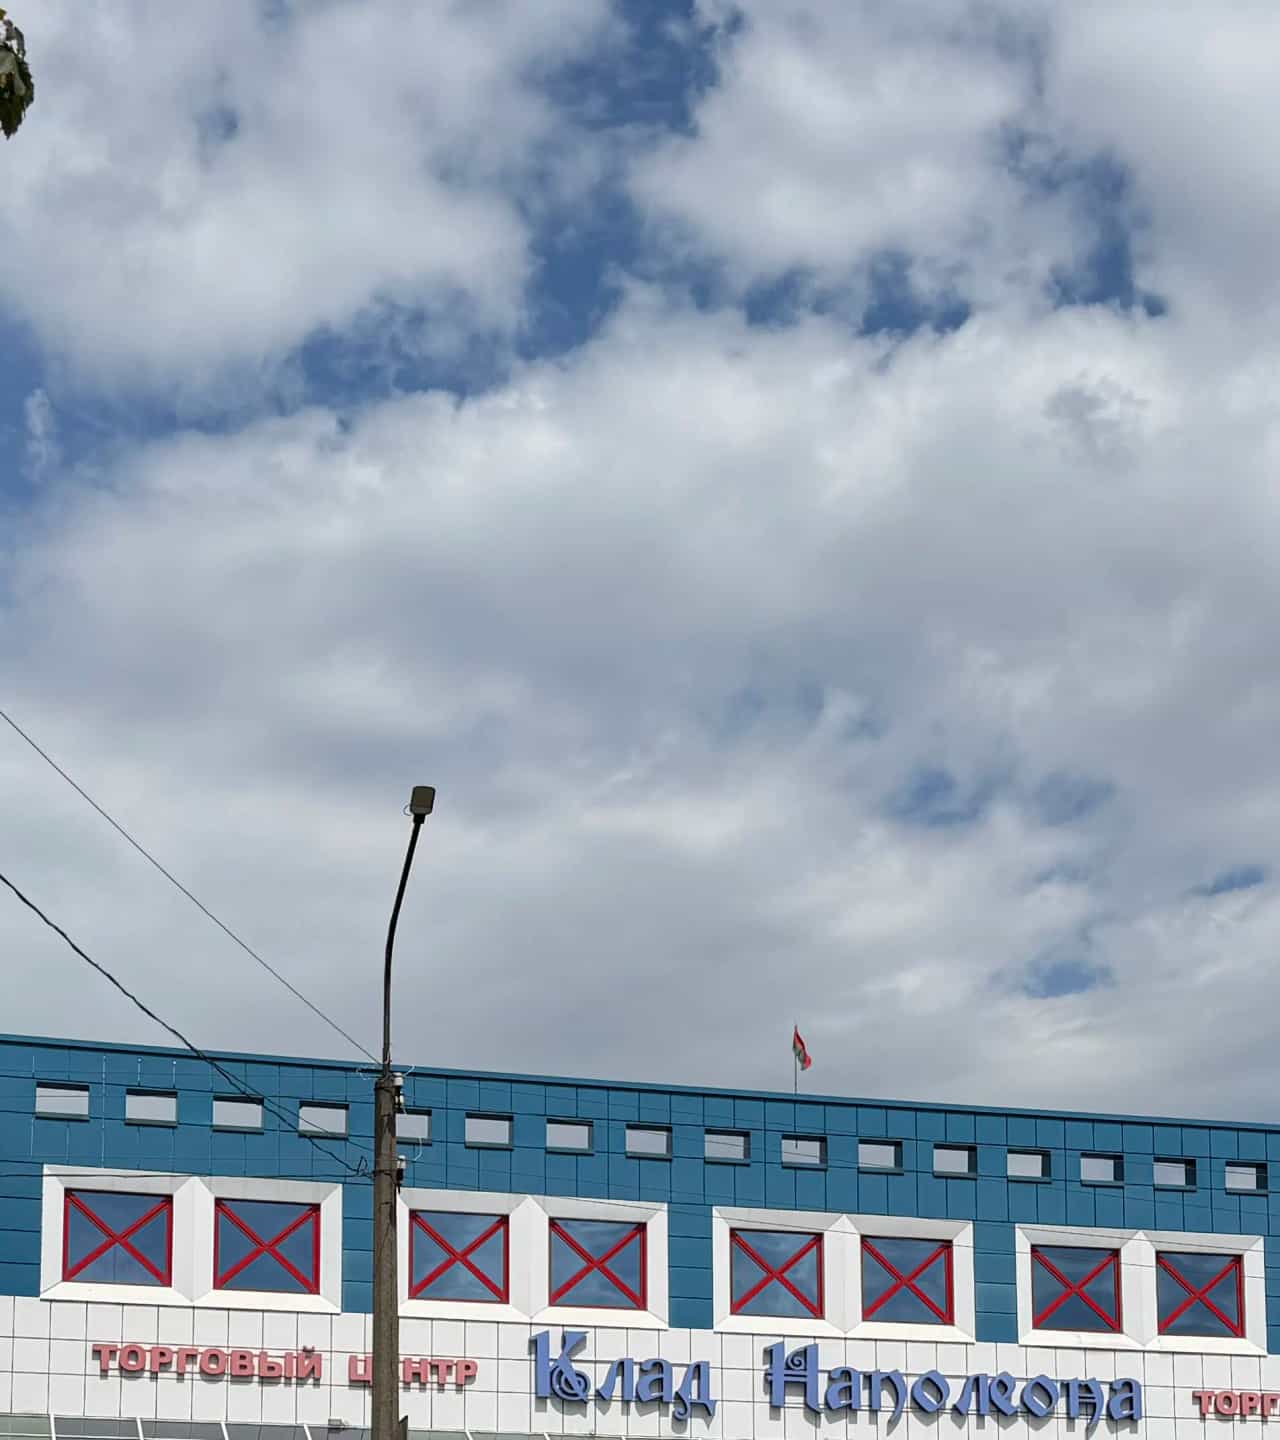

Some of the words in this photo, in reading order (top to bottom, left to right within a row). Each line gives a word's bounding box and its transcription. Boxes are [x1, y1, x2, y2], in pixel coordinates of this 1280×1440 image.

[92, 1344, 323, 1379] ТОРГОВЫЙ
[348, 1354, 479, 1386] ЦНТР
[530, 1329, 717, 1420] Клад
[764, 1341, 1144, 1426] Наполеона
